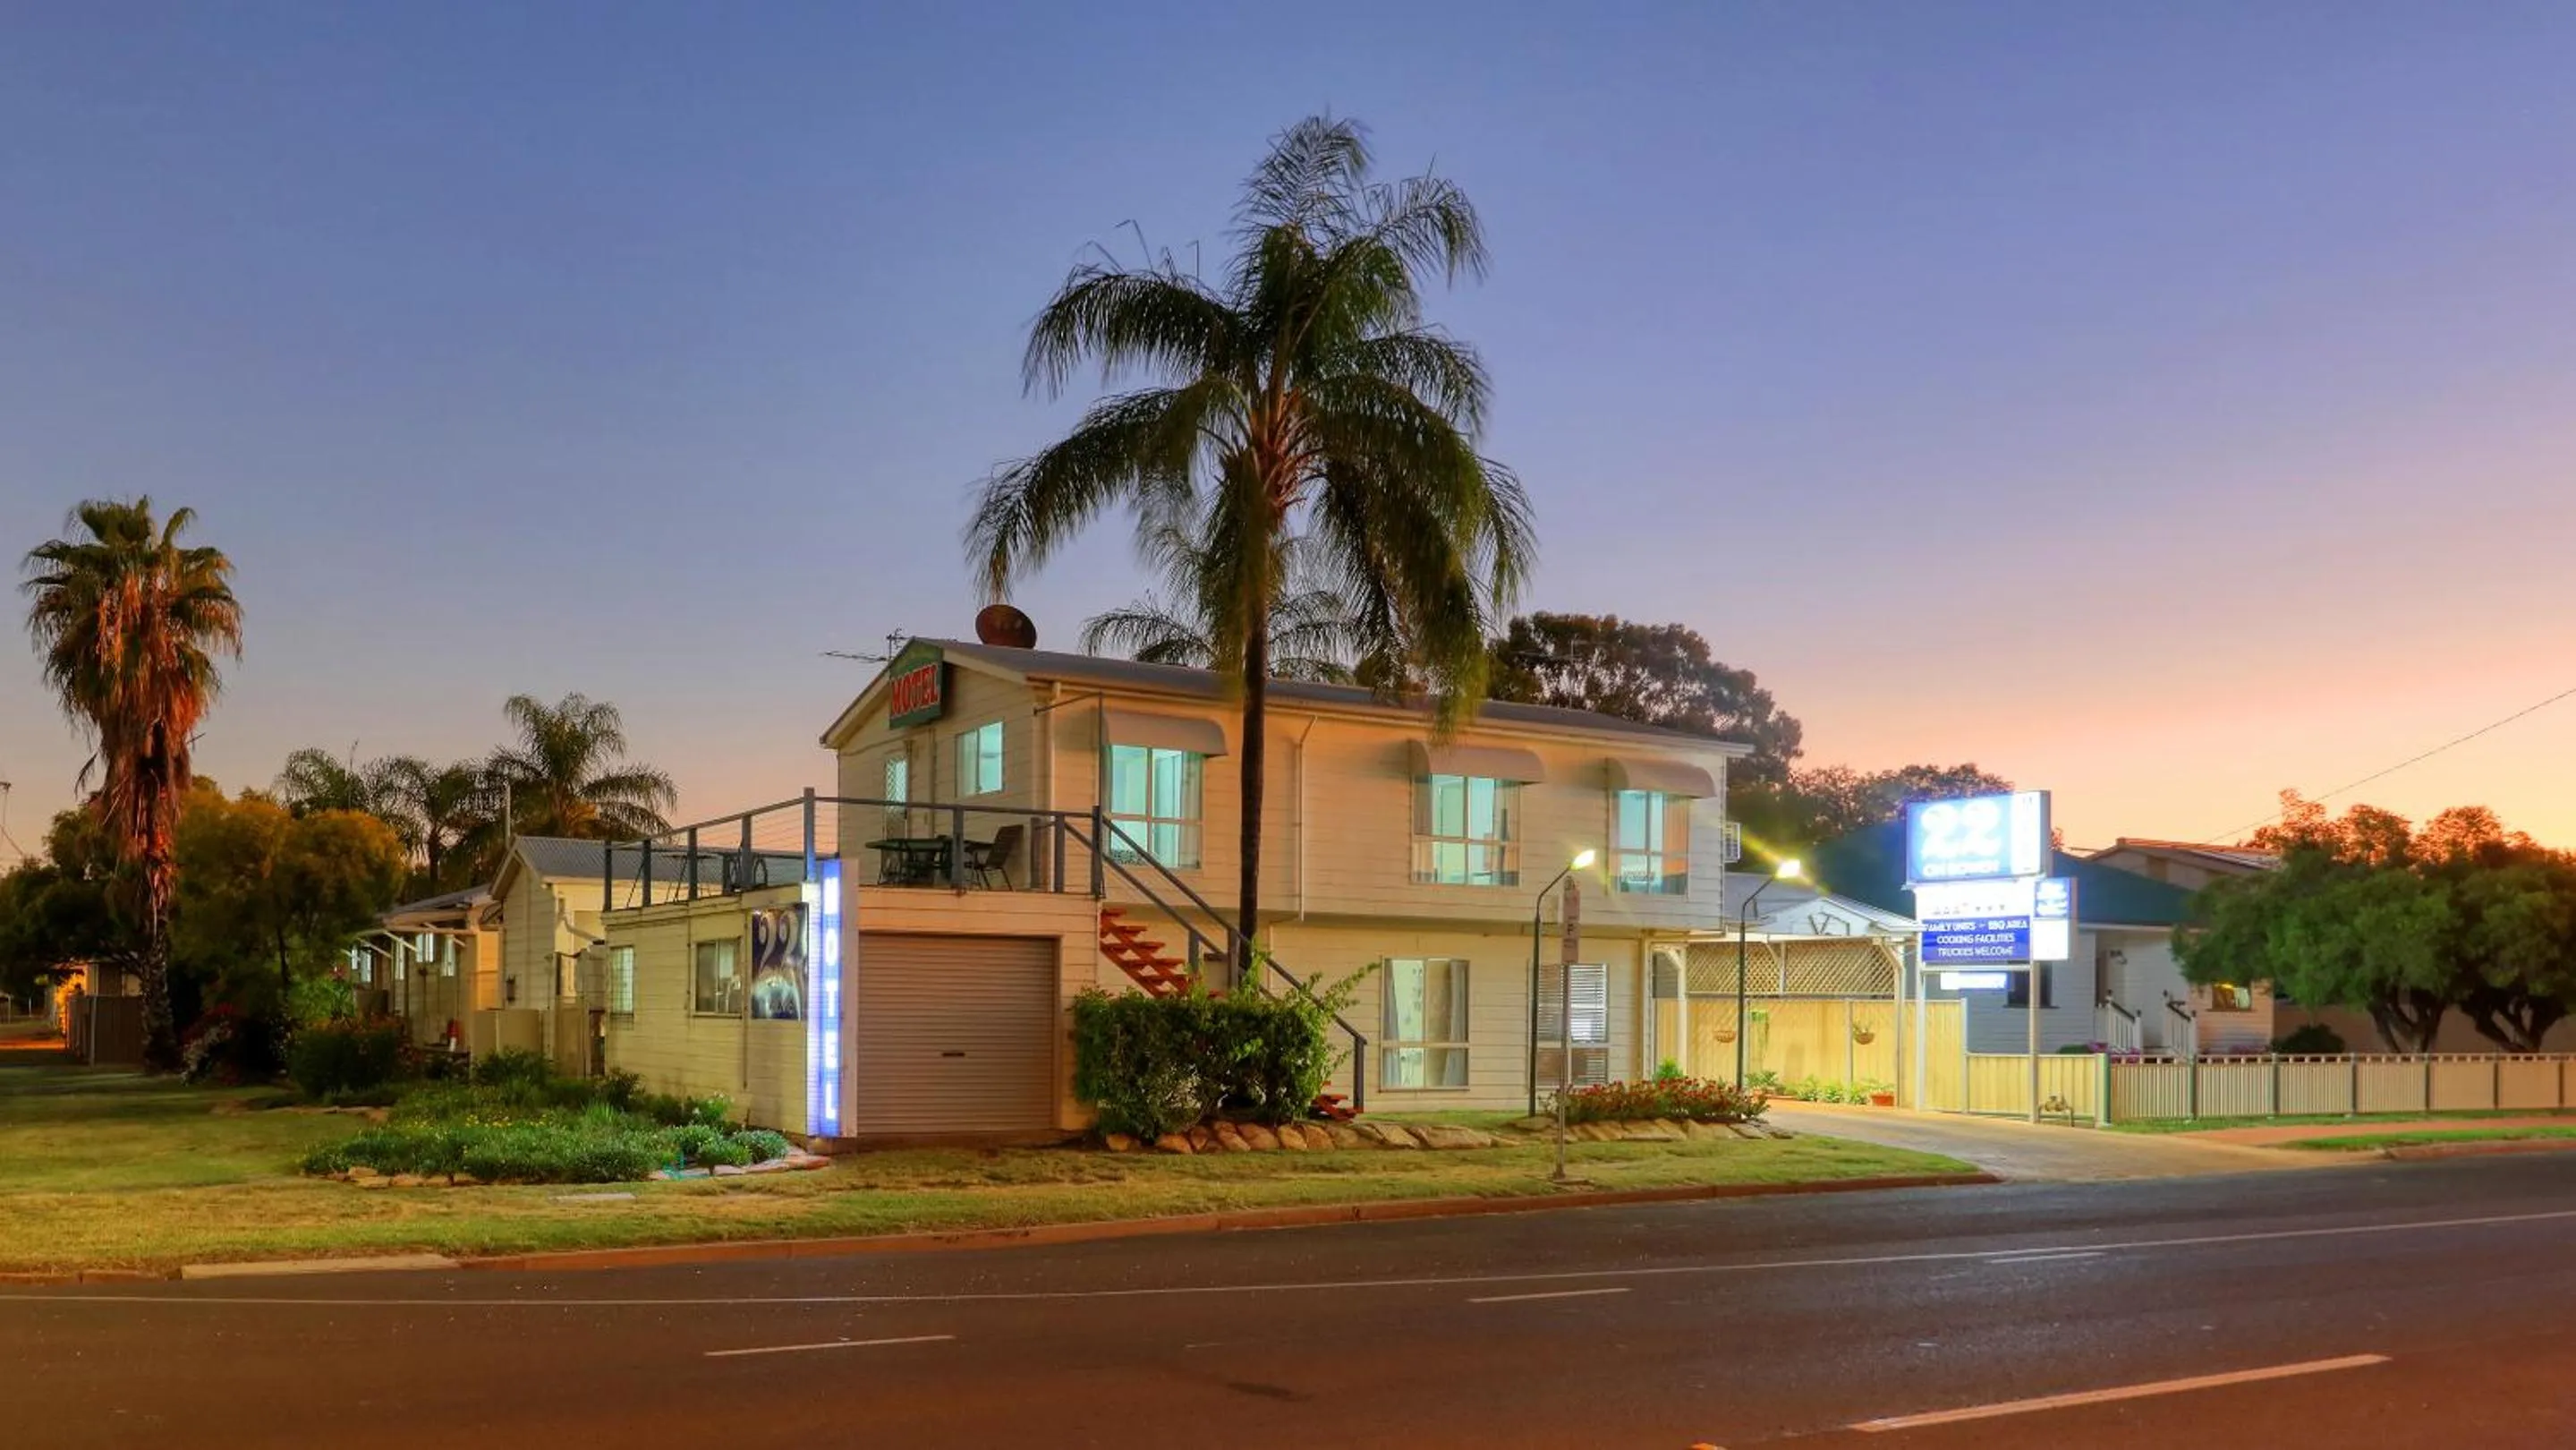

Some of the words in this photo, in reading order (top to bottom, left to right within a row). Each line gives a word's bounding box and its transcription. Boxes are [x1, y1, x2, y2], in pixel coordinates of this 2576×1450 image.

[889, 663, 939, 718] MOTEL
[1921, 800, 2002, 859] 22
[1936, 934, 1974, 944] COOKING
[1975, 932, 2015, 943] FACILITIES
[1975, 946, 2013, 956] WELCOME
[821, 877, 839, 1120] MOTEL
